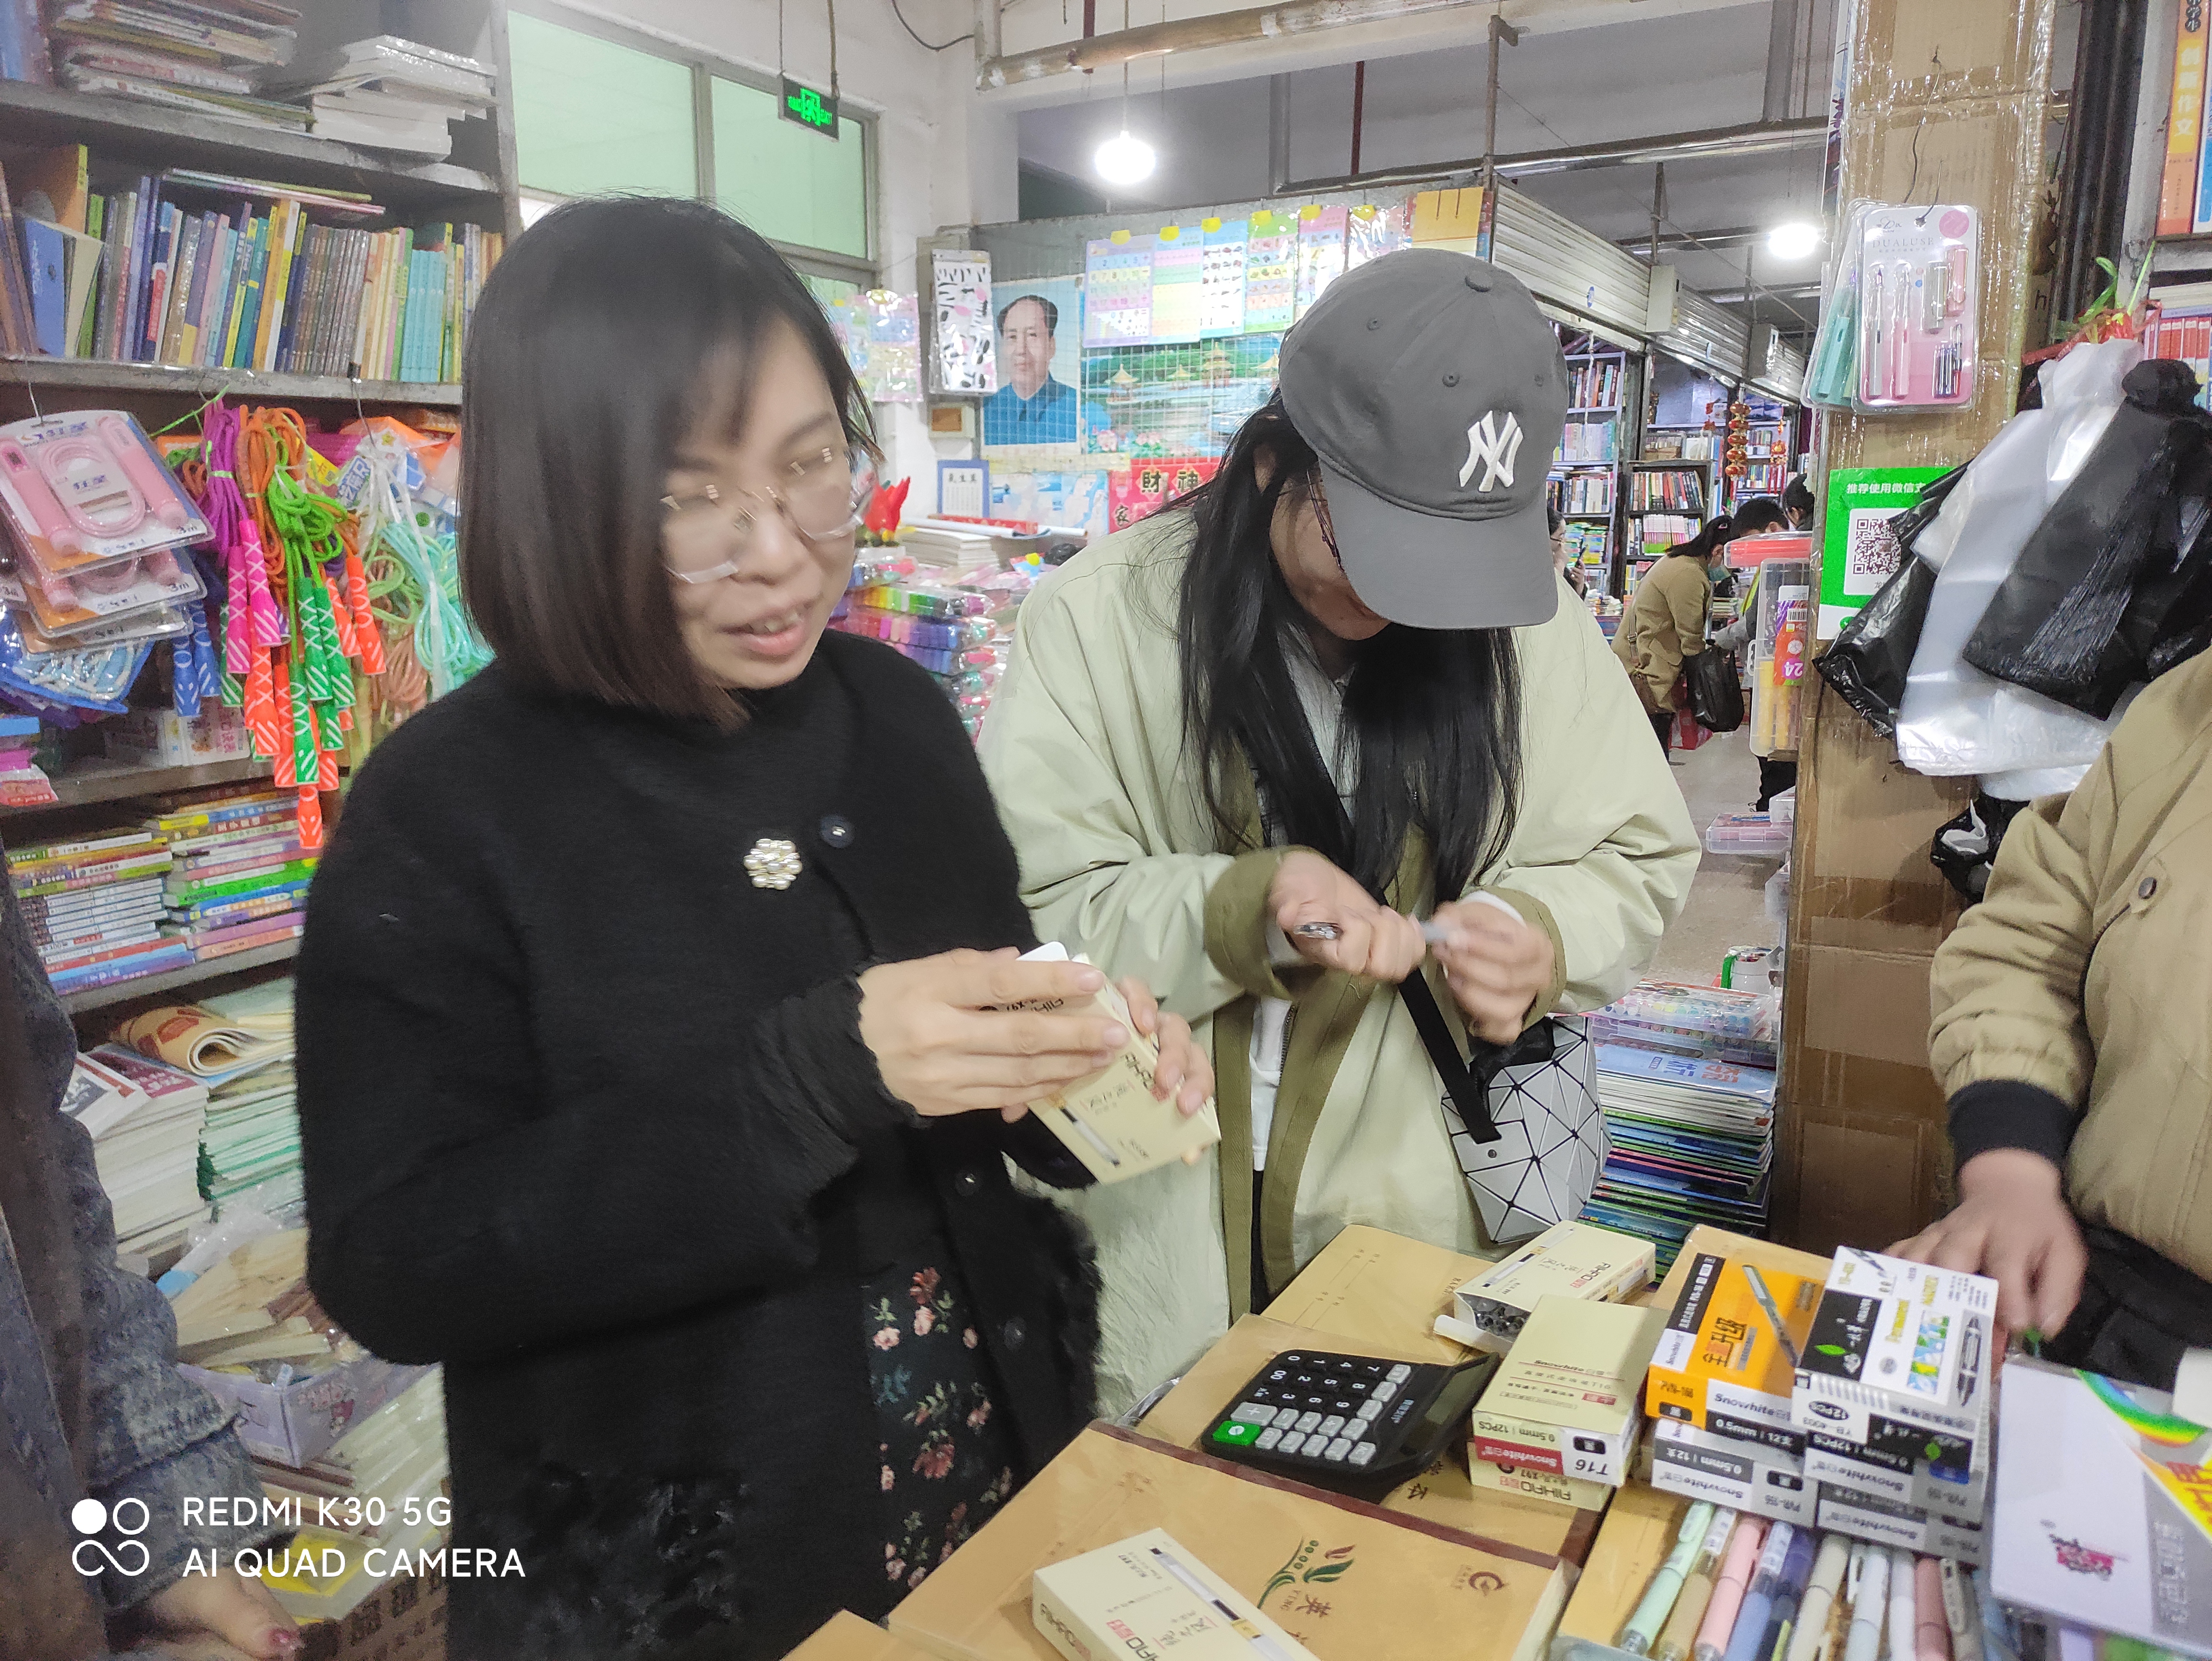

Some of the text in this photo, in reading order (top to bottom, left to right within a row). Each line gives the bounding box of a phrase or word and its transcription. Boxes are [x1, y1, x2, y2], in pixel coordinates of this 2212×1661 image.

[1872, 237, 1935, 248] DUALUSE
[1460, 412, 1523, 491] NY
[1783, 661, 1803, 675] 24
[1583, 1260, 1612, 1281] AIHAO
[1270, 1370, 1287, 1380] 00
[1367, 1364, 1381, 1373] 7
[1714, 1393, 1775, 1415] Snowhite
[1478, 1420, 1509, 1433] 12PCS
[1506, 1450, 1558, 1467] Snowhite
[1575, 1459, 1608, 1476] T16
[1520, 1480, 1571, 1500] AIHAO
[1683, 1477, 1744, 1499] Snowhite
[1295, 1593, 1332, 1619] 英
